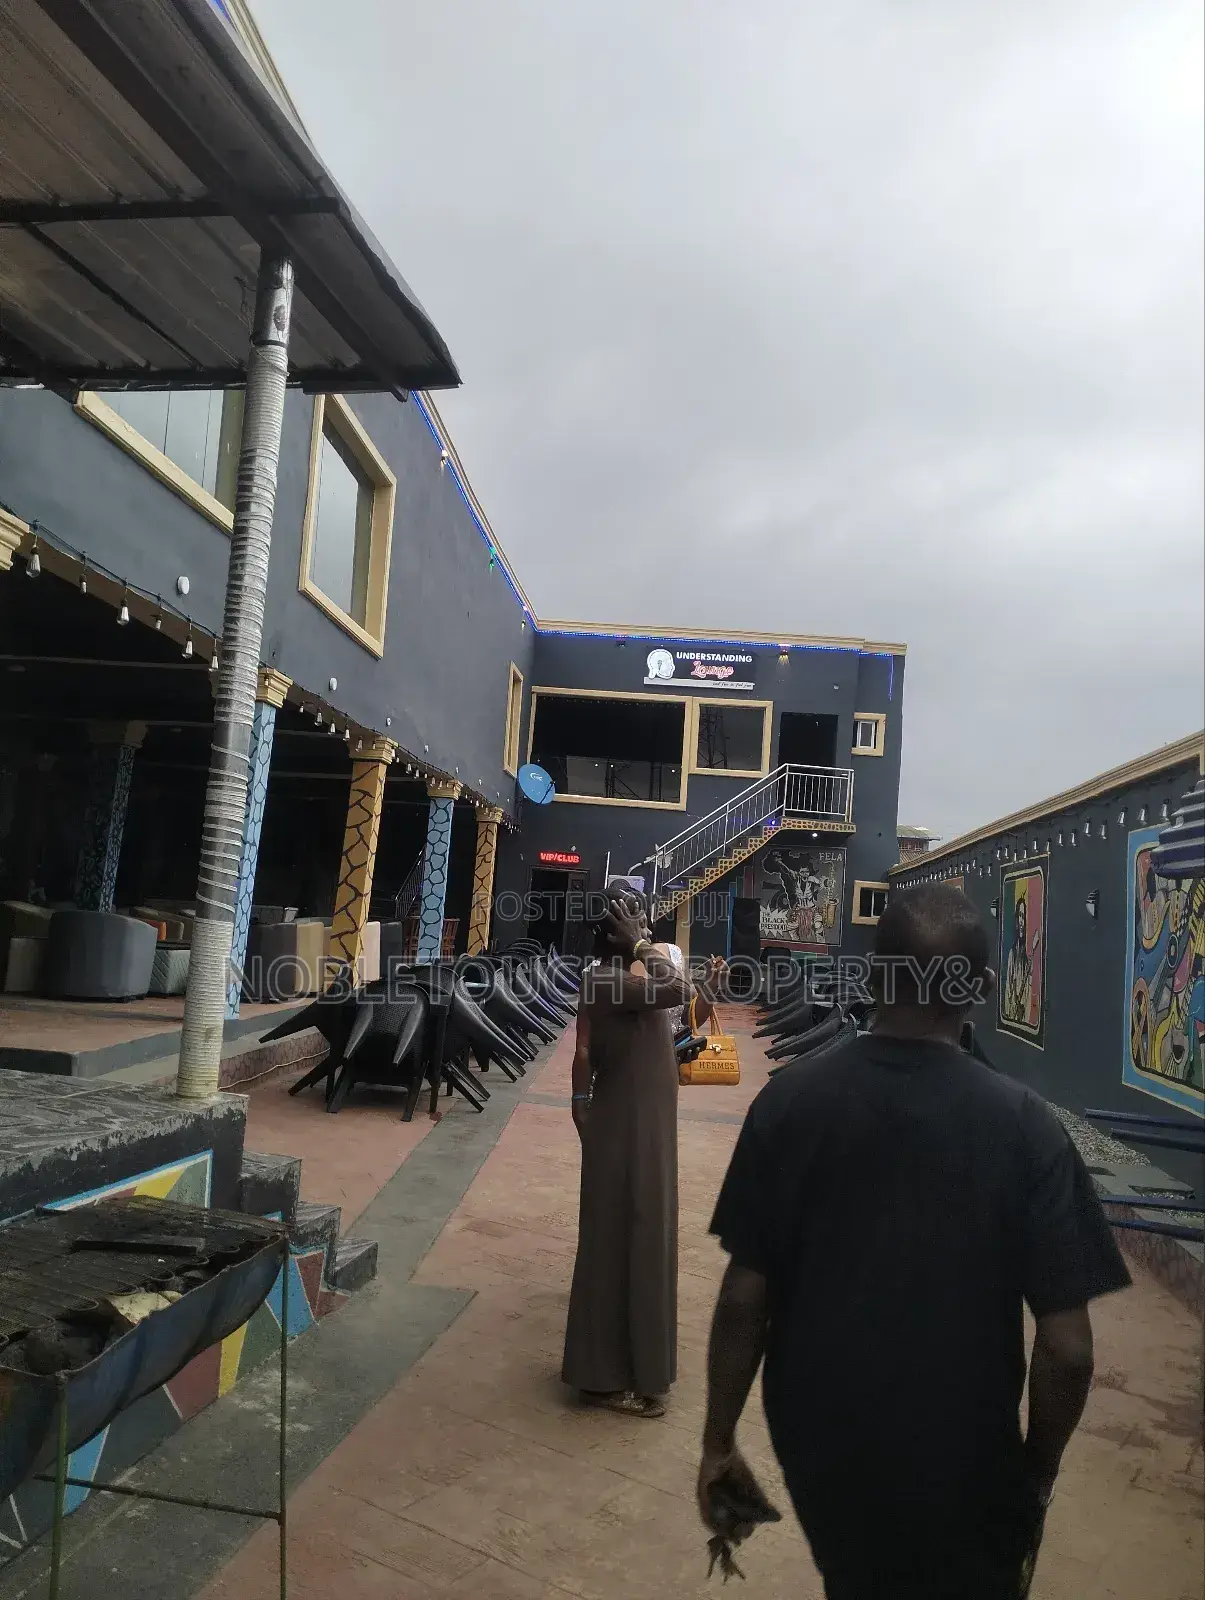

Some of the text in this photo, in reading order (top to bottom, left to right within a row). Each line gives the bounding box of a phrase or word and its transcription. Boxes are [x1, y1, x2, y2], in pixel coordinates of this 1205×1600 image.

[676, 651, 753, 663] UNDERSTANDING
[690, 660, 734, 679] Lounge
[540, 852, 580, 863] VIP/CLUB
[819, 852, 842, 861] FELA
[699, 1061, 735, 1070] HERMES
